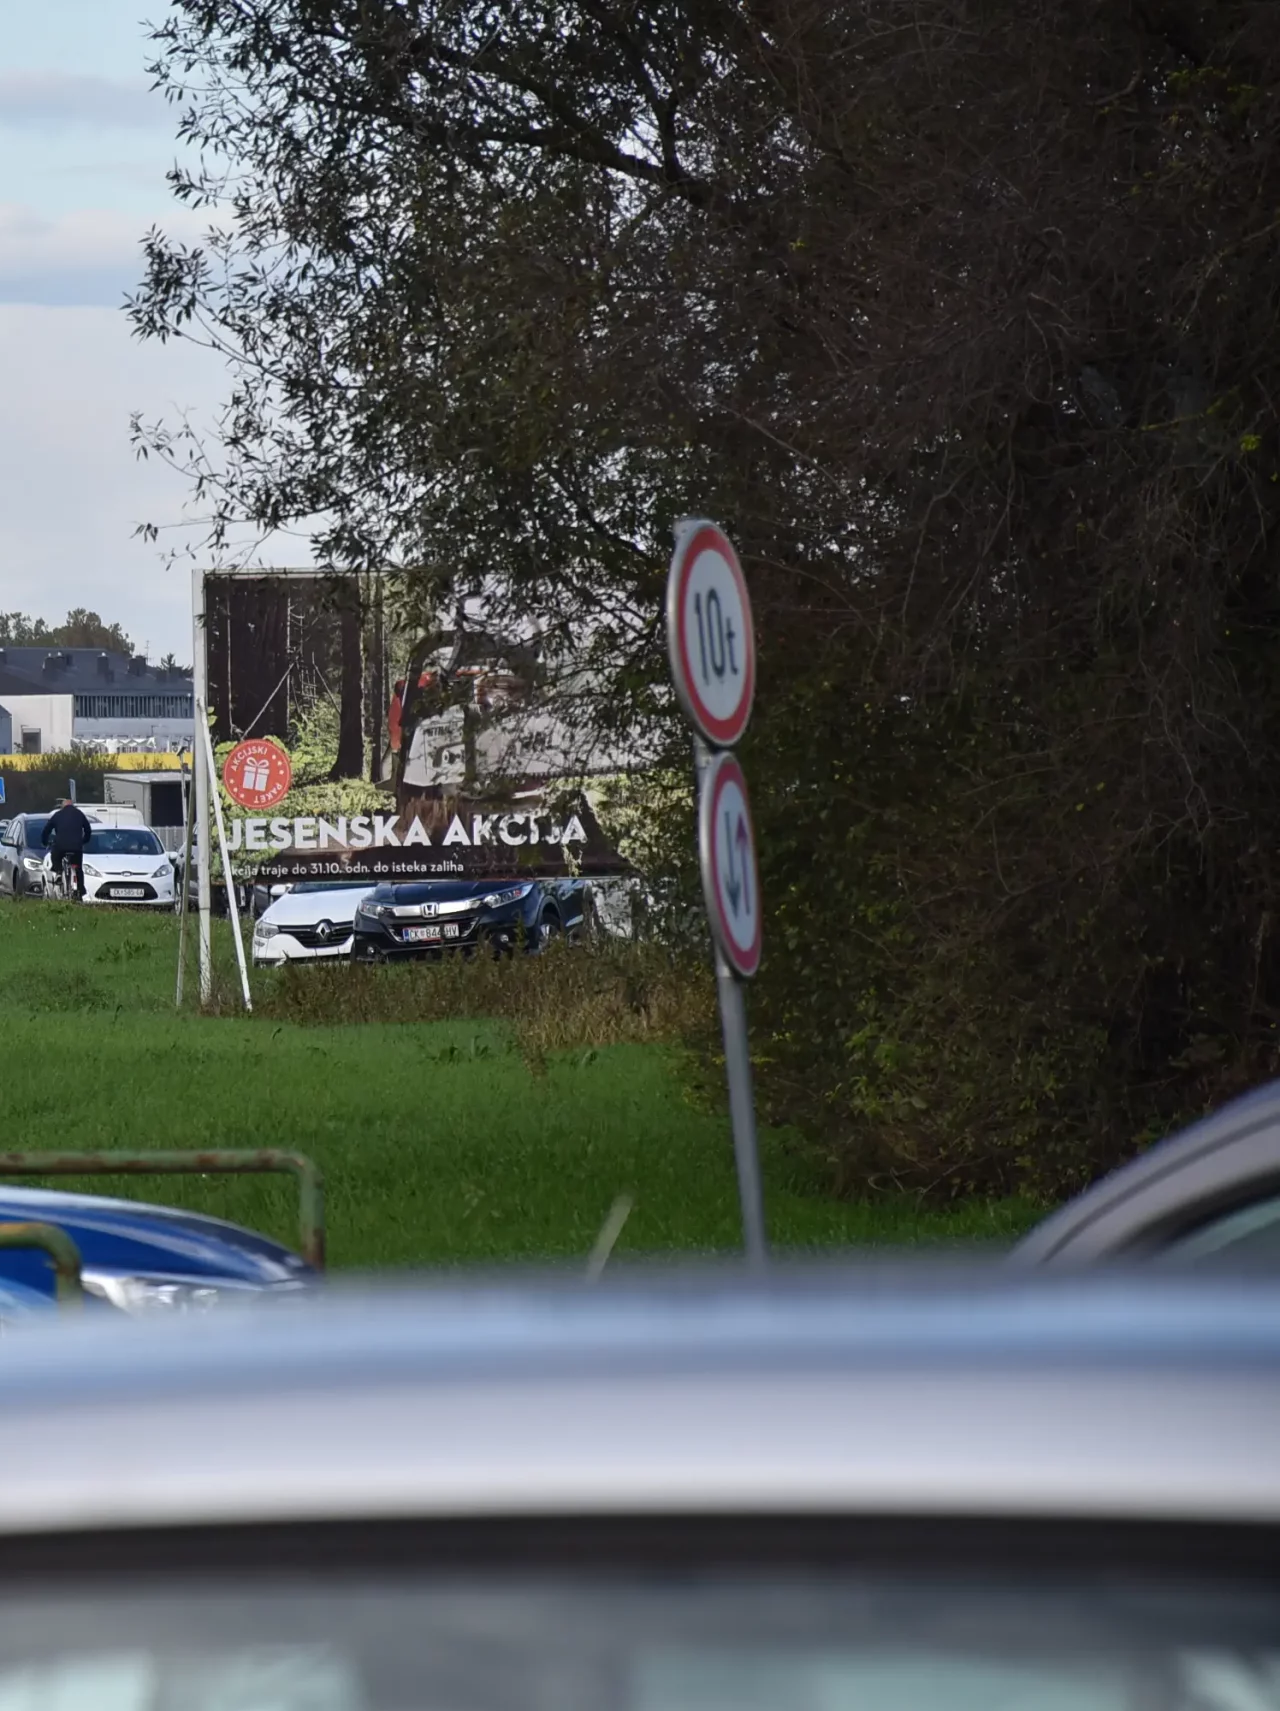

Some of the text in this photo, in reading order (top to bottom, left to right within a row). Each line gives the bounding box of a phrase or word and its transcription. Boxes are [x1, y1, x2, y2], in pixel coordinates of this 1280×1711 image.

[694, 586, 738, 687] 10t
[230, 746, 268, 772] AKCIJSKI
[254, 782, 283, 804] PAKET
[227, 813, 588, 851] JESENSKA AKCIJA
[261, 864, 288, 878] traje
[292, 863, 307, 875] do
[310, 863, 343, 874] 31.10.
[346, 862, 371, 874] odn.
[373, 862, 389, 873] do
[392, 861, 428, 873] isteka
[430, 861, 464, 873] zaliha
